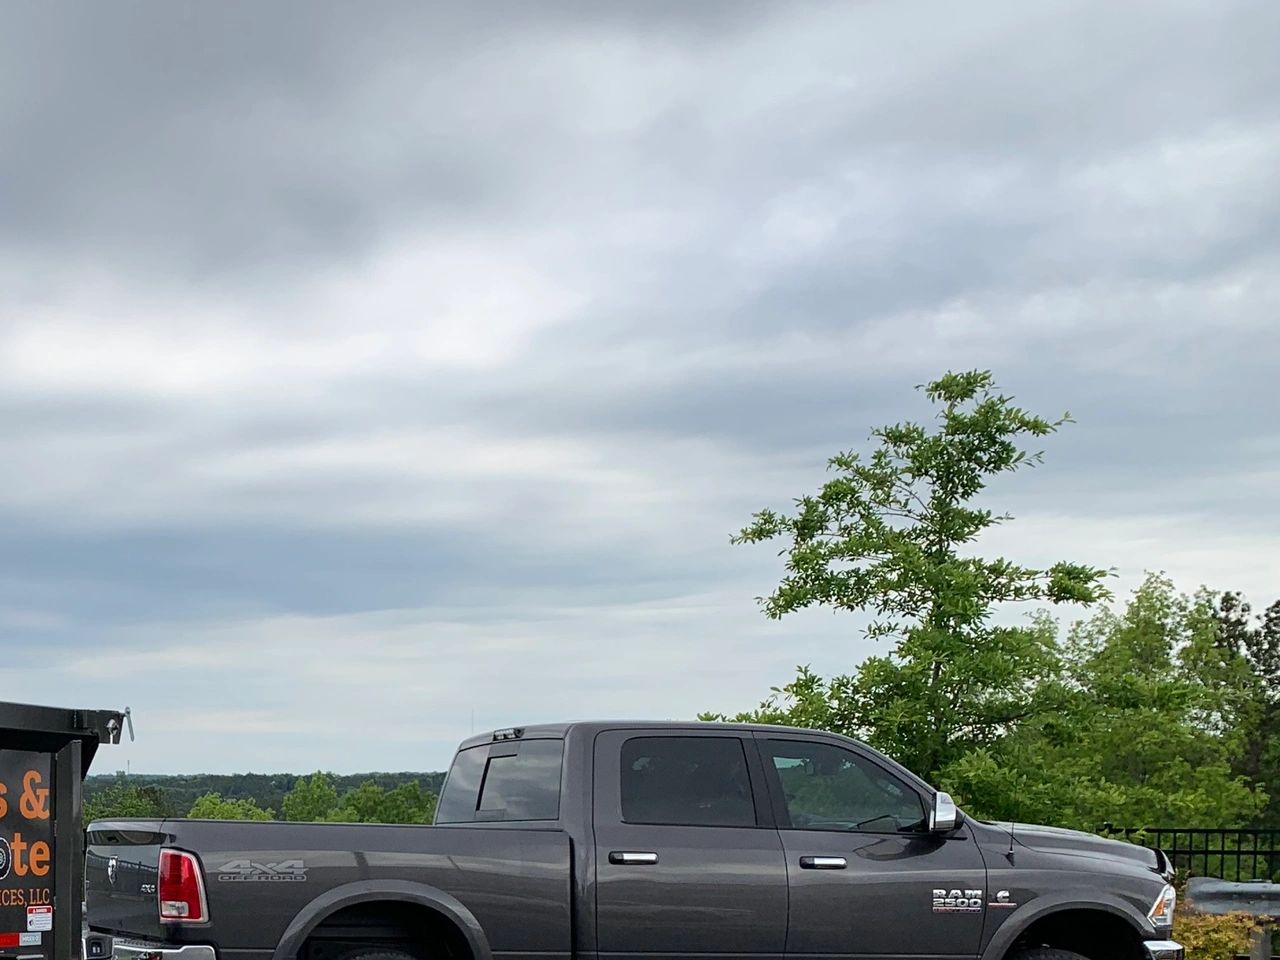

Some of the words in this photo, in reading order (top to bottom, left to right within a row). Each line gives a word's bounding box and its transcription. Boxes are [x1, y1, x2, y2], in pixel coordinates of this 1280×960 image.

[19, 770, 50, 820] &
[29, 888, 50, 905] LLC
[932, 889, 983, 898] RAM
[933, 899, 982, 907] 2500
